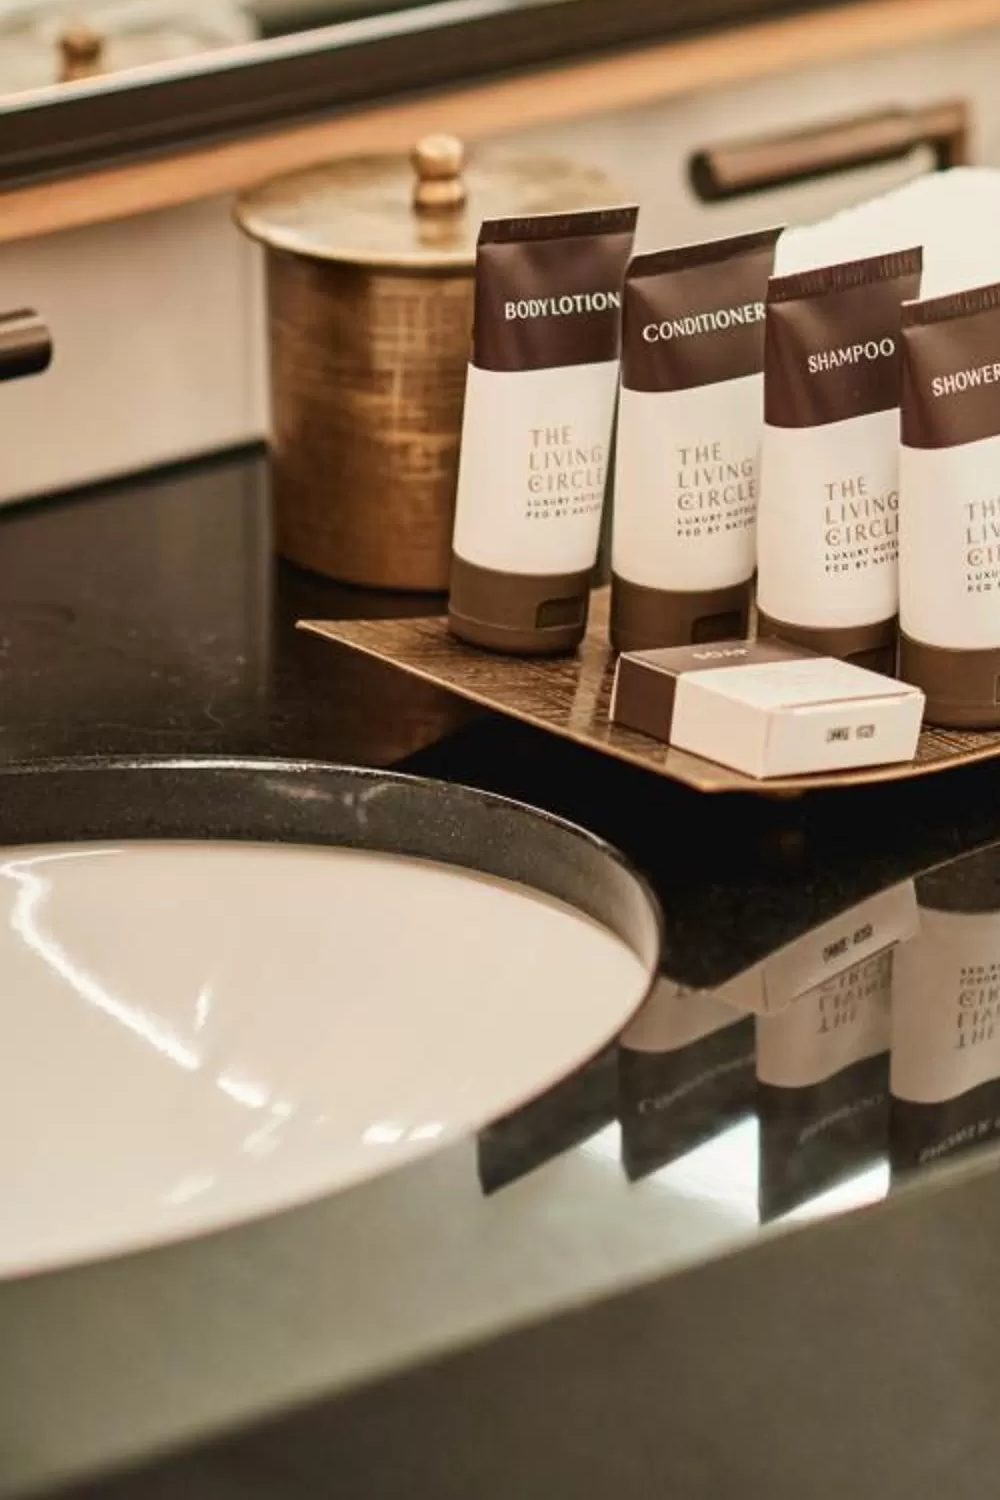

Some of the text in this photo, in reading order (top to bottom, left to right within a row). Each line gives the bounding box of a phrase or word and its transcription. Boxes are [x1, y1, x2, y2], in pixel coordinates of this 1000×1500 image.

[505, 291, 621, 320] BODYLOTION
[642, 302, 766, 343] CONDITIONER
[808, 338, 895, 374] SHAMPOO
[527, 425, 573, 448] THE
[528, 445, 603, 470] LIVING
[677, 442, 721, 466] THE
[678, 457, 754, 489] LIVING
[677, 480, 756, 511] CIRCLE
[824, 477, 868, 501] THE
[825, 491, 899, 525] LIVING
